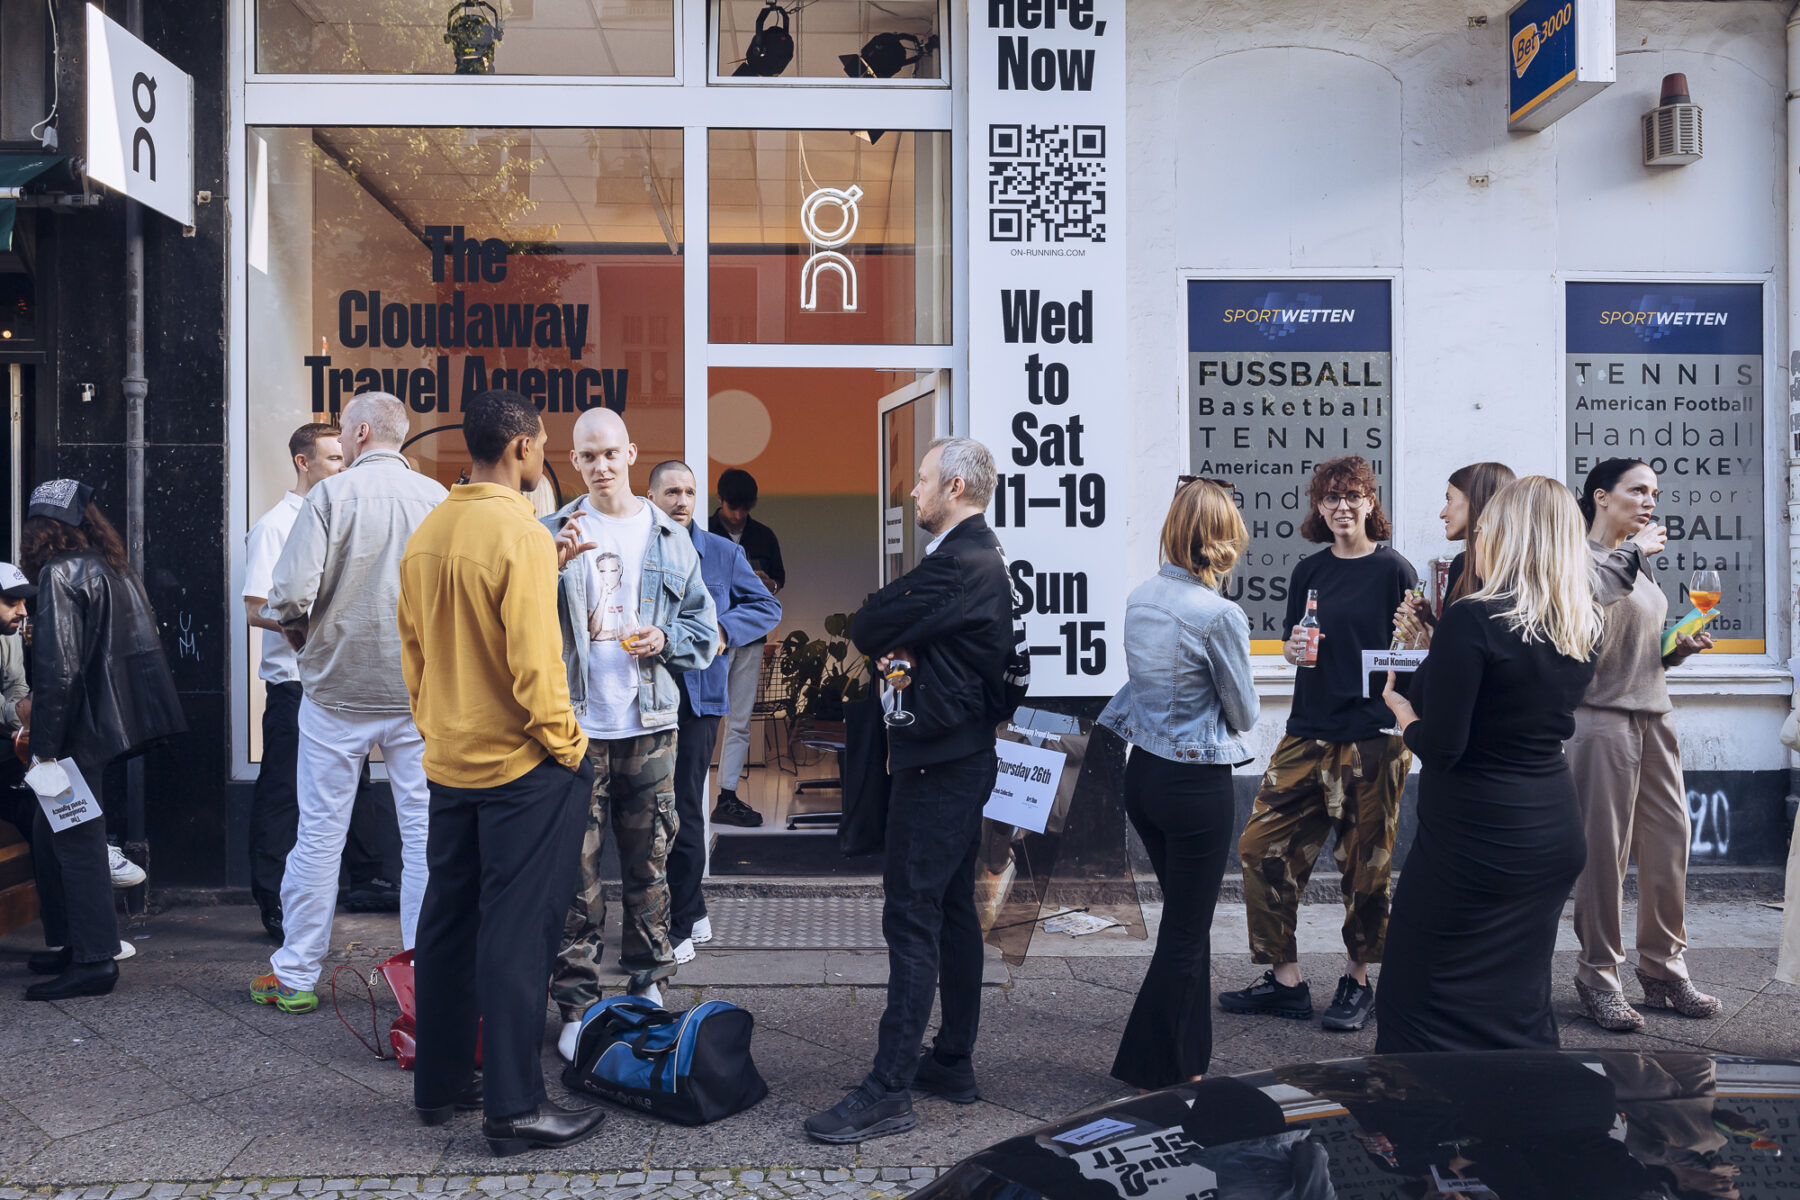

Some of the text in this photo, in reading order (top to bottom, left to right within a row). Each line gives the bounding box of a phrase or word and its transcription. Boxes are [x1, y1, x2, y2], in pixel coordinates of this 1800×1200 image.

[988, 0, 1107, 36] Here,
[998, 36, 1096, 91] Now
[424, 225, 507, 283] The
[1010, 249, 1086, 257] ON-RUNNING.COM
[339, 290, 589, 360] Cloudaway
[1000, 289, 1093, 344] Wed
[1223, 309, 1355, 323] SPORTWETTEN
[1600, 311, 1728, 325] SPORTWETTEN
[304, 355, 449, 413] Travel
[1024, 353, 1069, 405] to
[1199, 361, 1382, 387] FUSSBALL
[1575, 362, 1752, 385] TENNIS
[1199, 397, 1382, 416] Basketball
[1575, 396, 1752, 411] American Football
[1011, 411, 1084, 467] Sat
[1199, 427, 1382, 449] TENNIS
[1574, 422, 1752, 446] Handball
[1200, 460, 1293, 475] American
[1575, 456, 1752, 475] EOCKEY
[1009, 559, 1088, 614] Sun
[1373, 656, 1421, 667] Paul Kominek
[997, 757, 1052, 785] Thursday 26th
